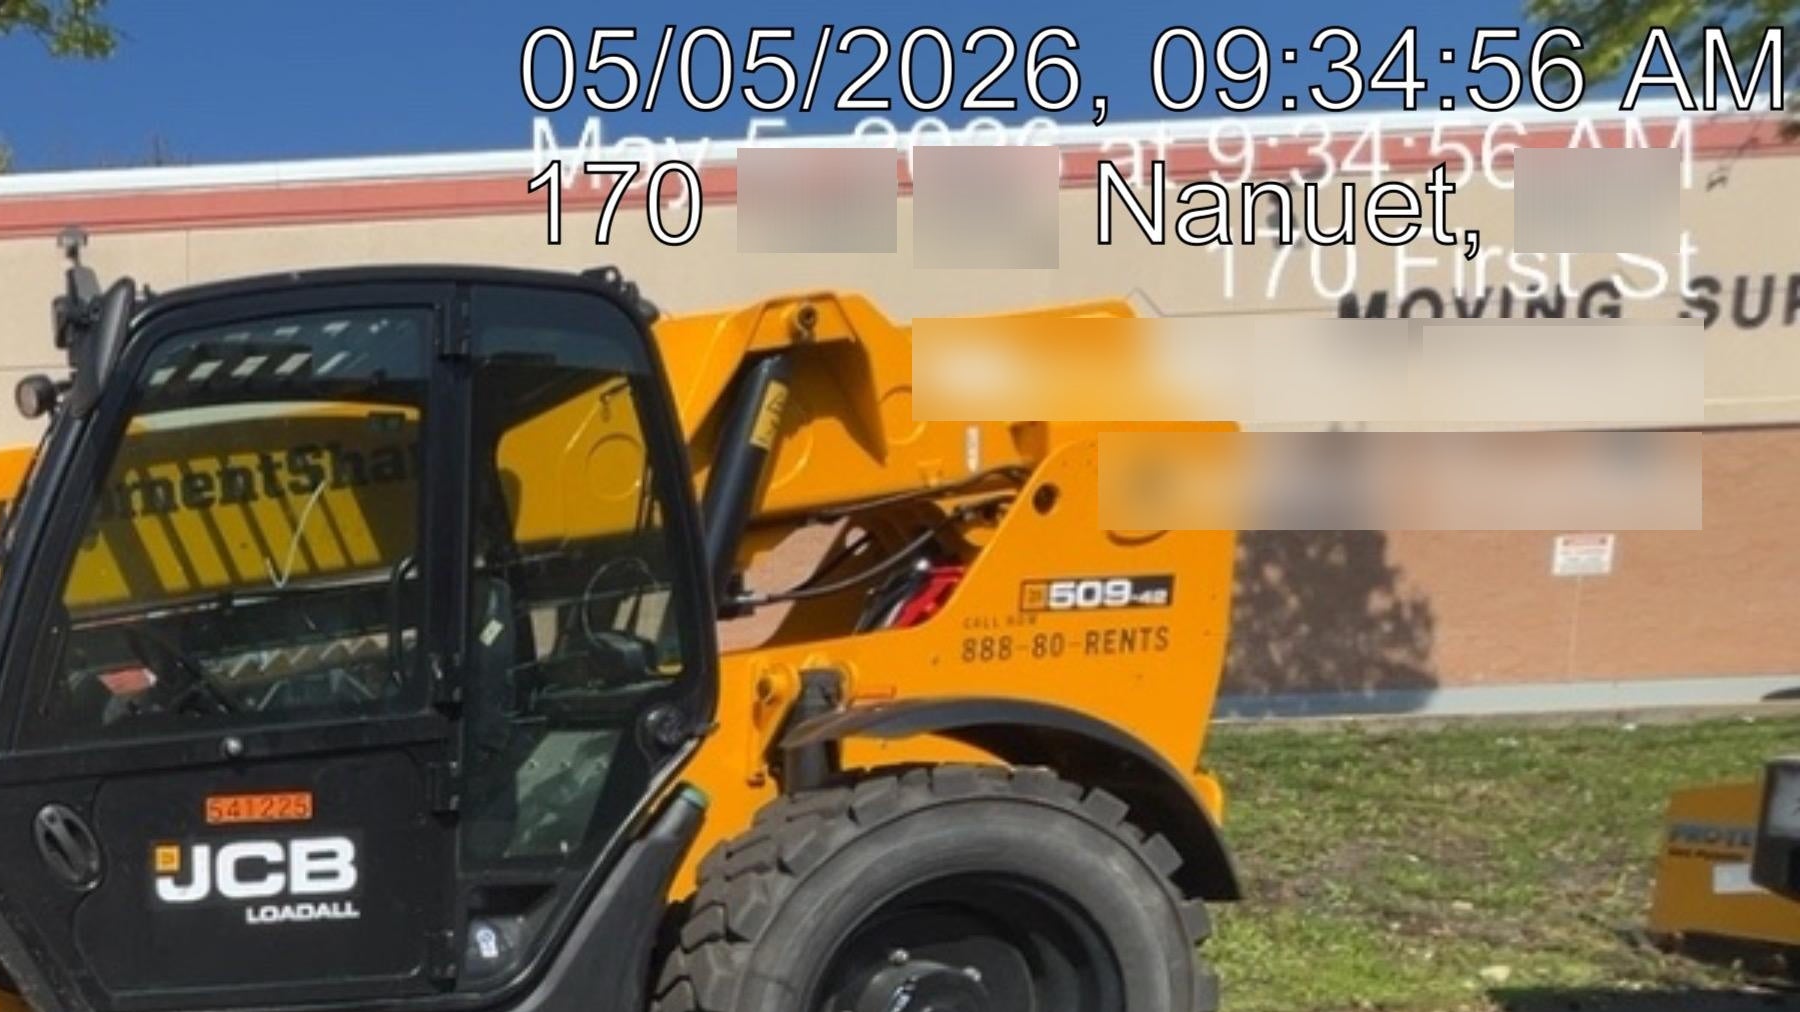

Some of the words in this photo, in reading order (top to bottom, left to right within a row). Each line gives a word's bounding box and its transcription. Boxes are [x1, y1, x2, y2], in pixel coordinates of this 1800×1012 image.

[961, 626, 1171, 664] 888-80-RENTS
[155, 835, 359, 903] JCB
[245, 900, 361, 924] LOADALL
